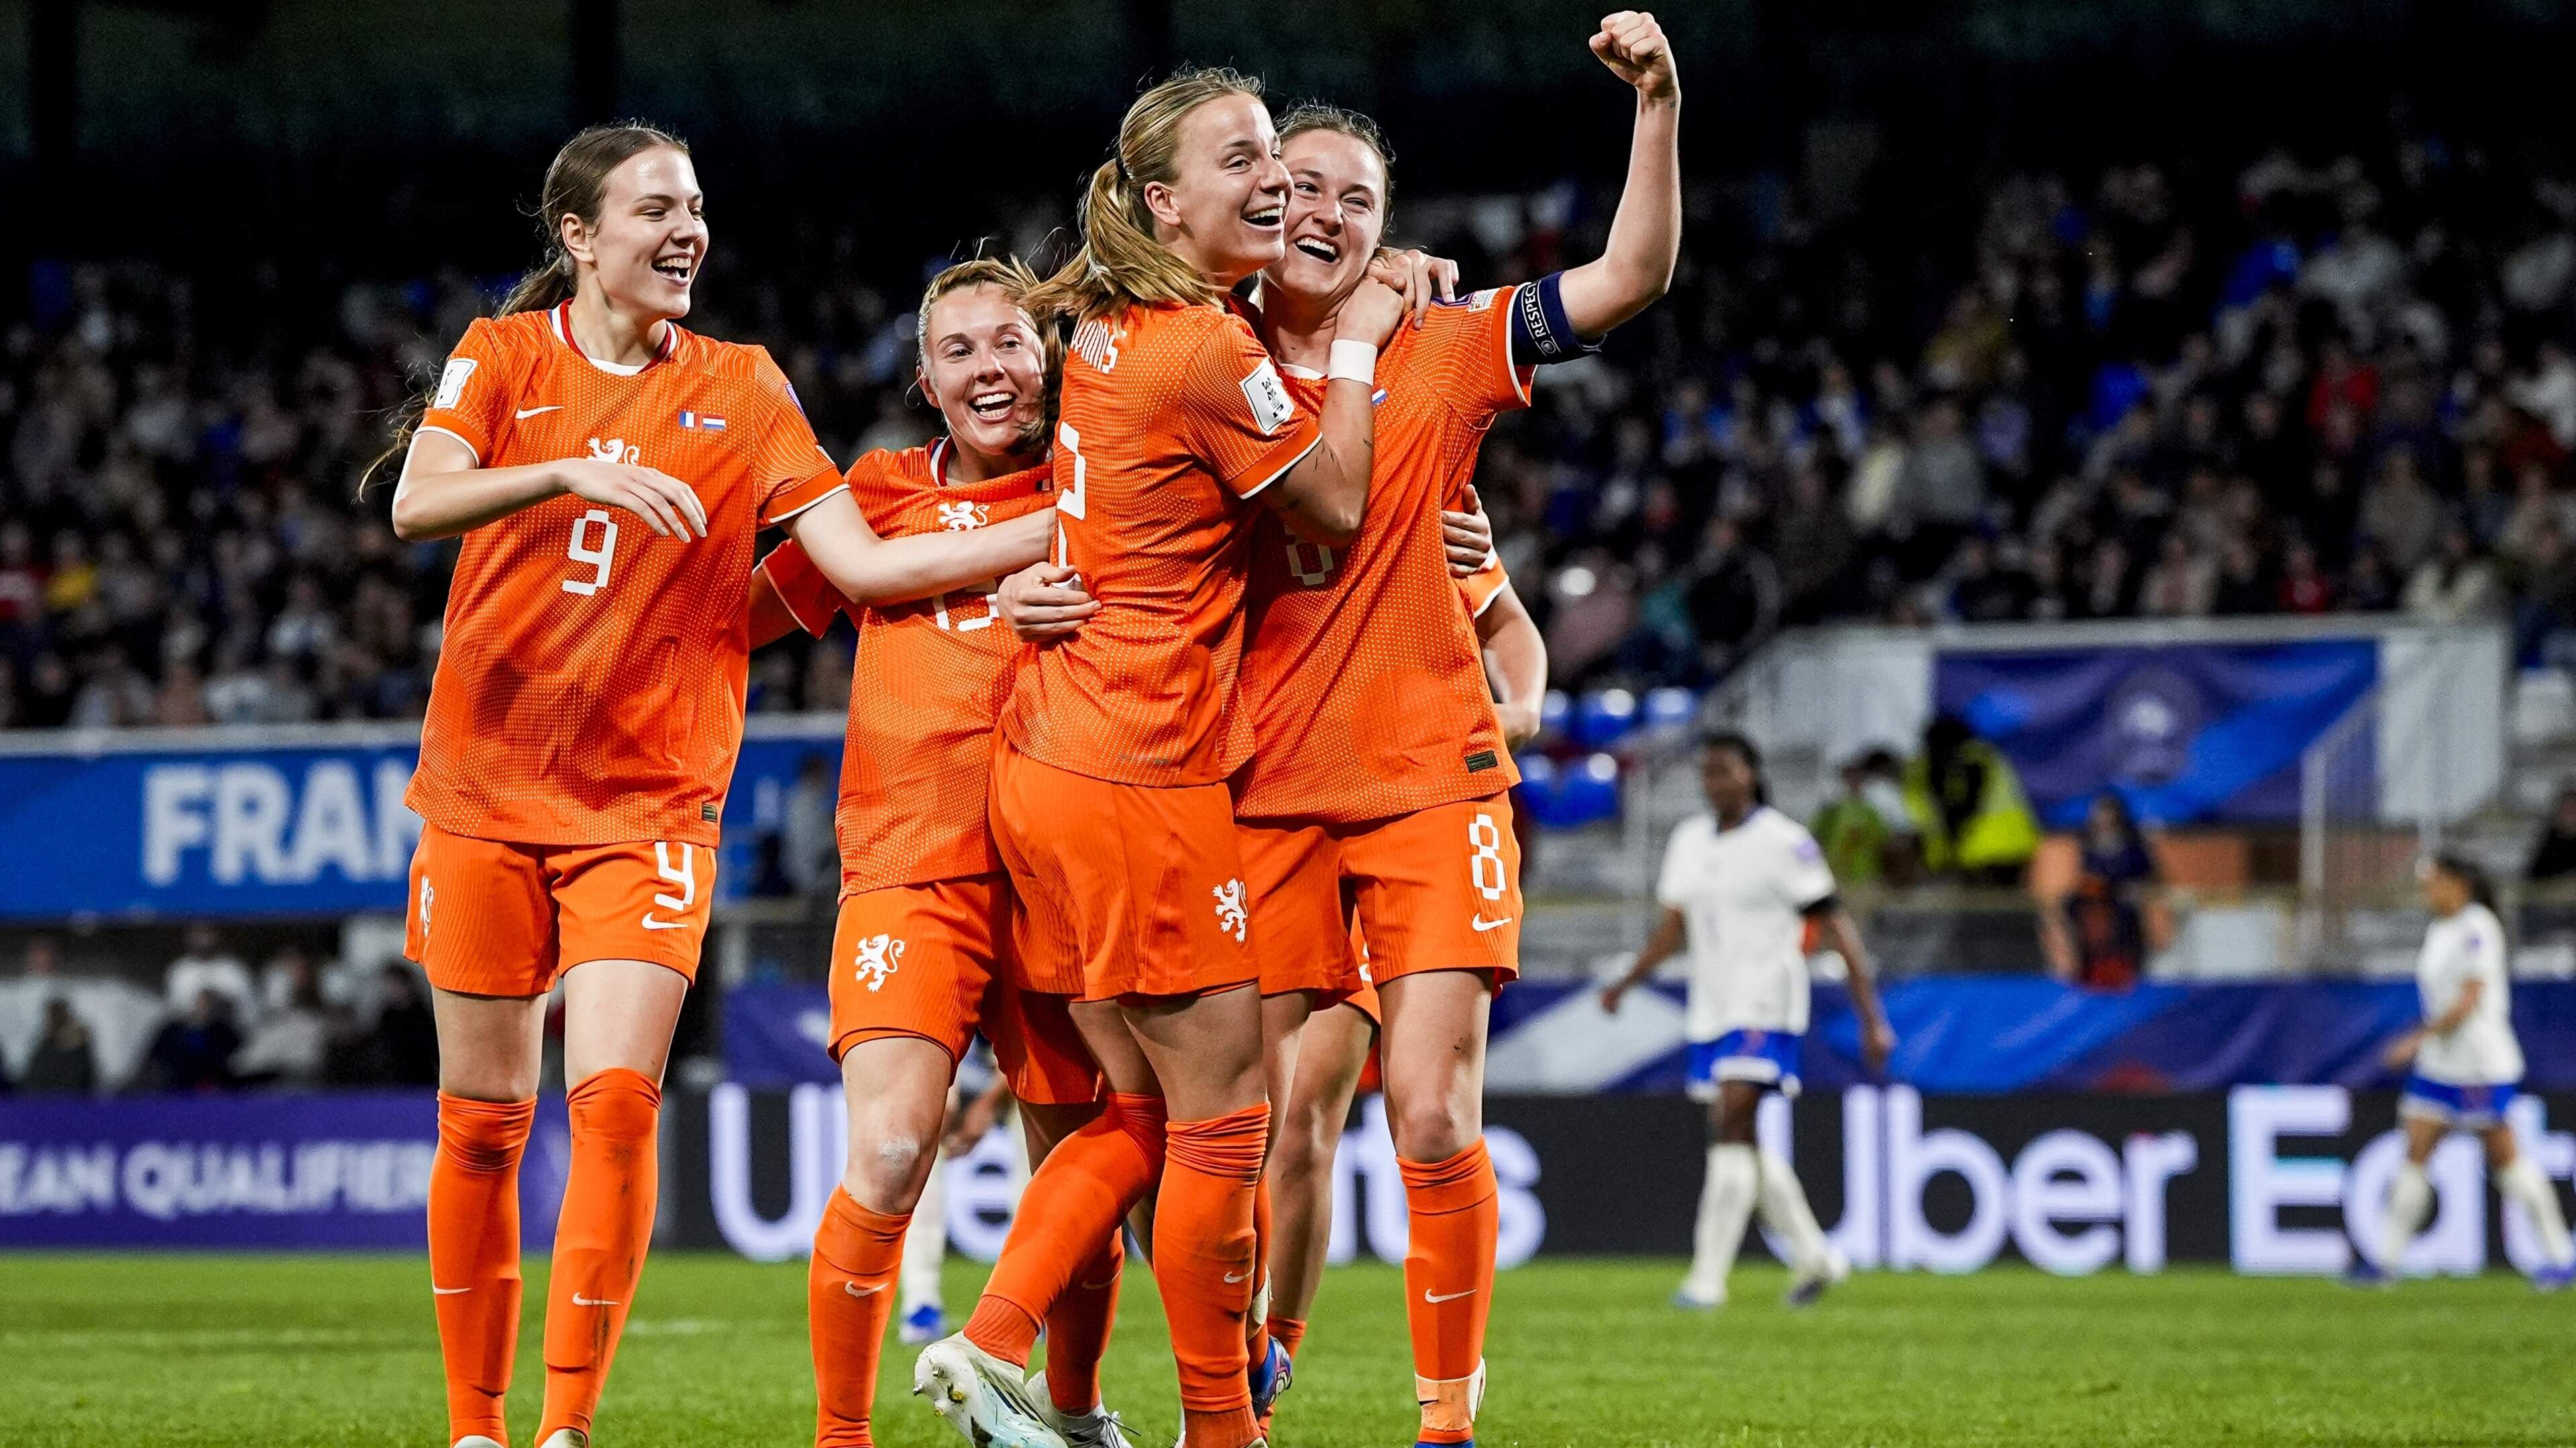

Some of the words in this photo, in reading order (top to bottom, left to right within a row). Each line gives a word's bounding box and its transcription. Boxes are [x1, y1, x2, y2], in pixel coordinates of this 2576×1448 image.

[562, 508, 617, 596] 9
[655, 842, 695, 911] 9
[1468, 814, 1507, 901] 8
[1755, 1082, 2200, 1276] Uber
[2226, 1083, 2576, 1276] Eat
